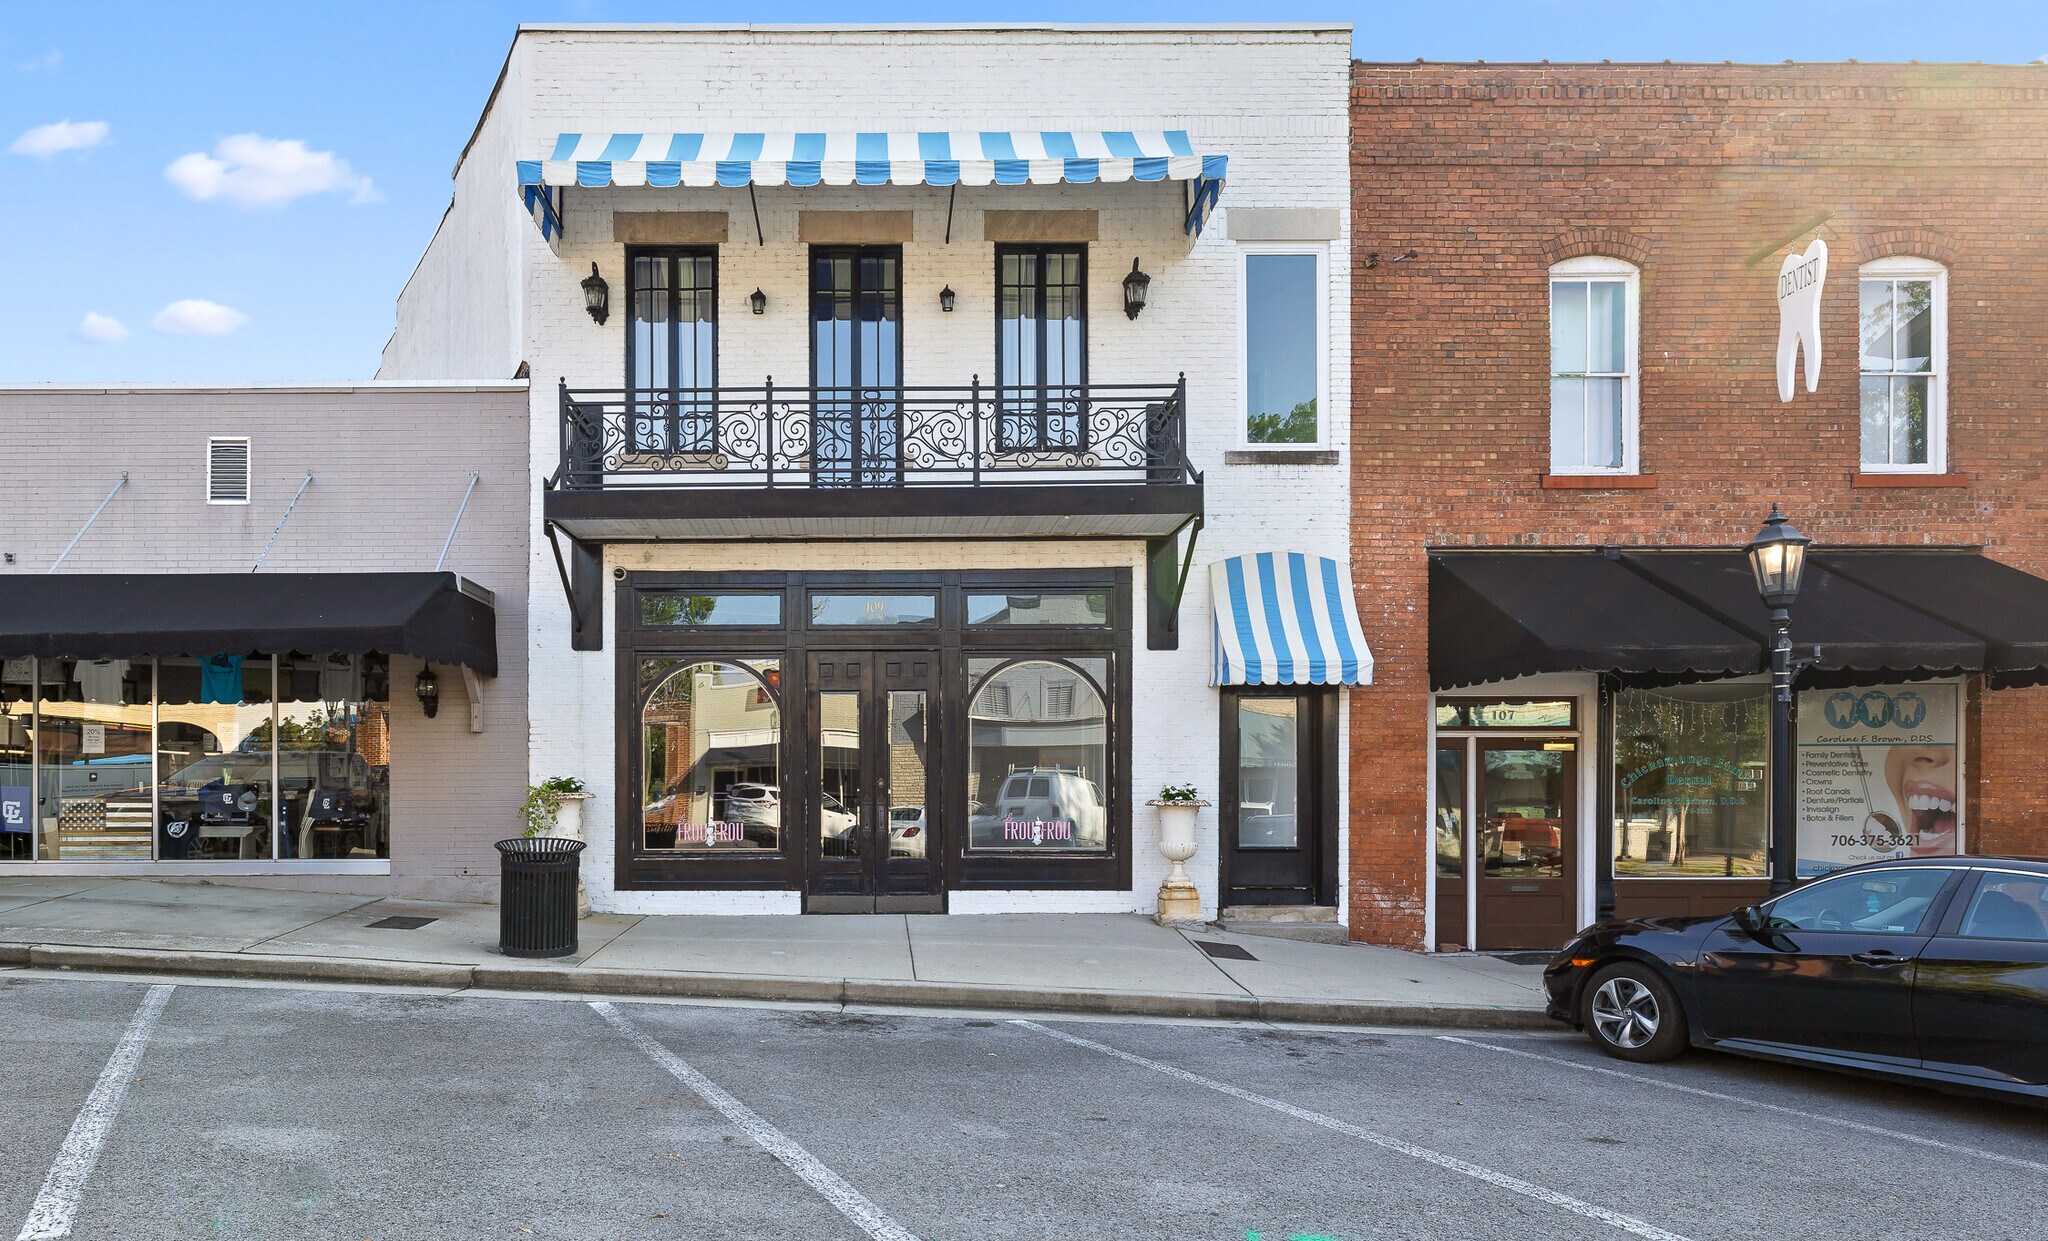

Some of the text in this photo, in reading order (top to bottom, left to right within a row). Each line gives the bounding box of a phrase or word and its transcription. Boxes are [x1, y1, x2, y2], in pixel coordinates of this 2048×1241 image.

[1781, 257, 1818, 299] DENTIST
[866, 601, 884, 613] 109
[1492, 710, 1515, 721] 107
[1816, 735, 1859, 743] Caroline
[1621, 755, 1711, 789] Chickamauga
[1841, 769, 1873, 777] Dentistry
[1667, 774, 1712, 786] Dental
[1824, 787, 1851, 795] Canals
[1631, 796, 1672, 805] Caroline
[1806, 796, 1865, 804] Denture/Partials
[1806, 806, 1840, 814] Invisalign
[1831, 835, 1920, 847] 706-375-3621
